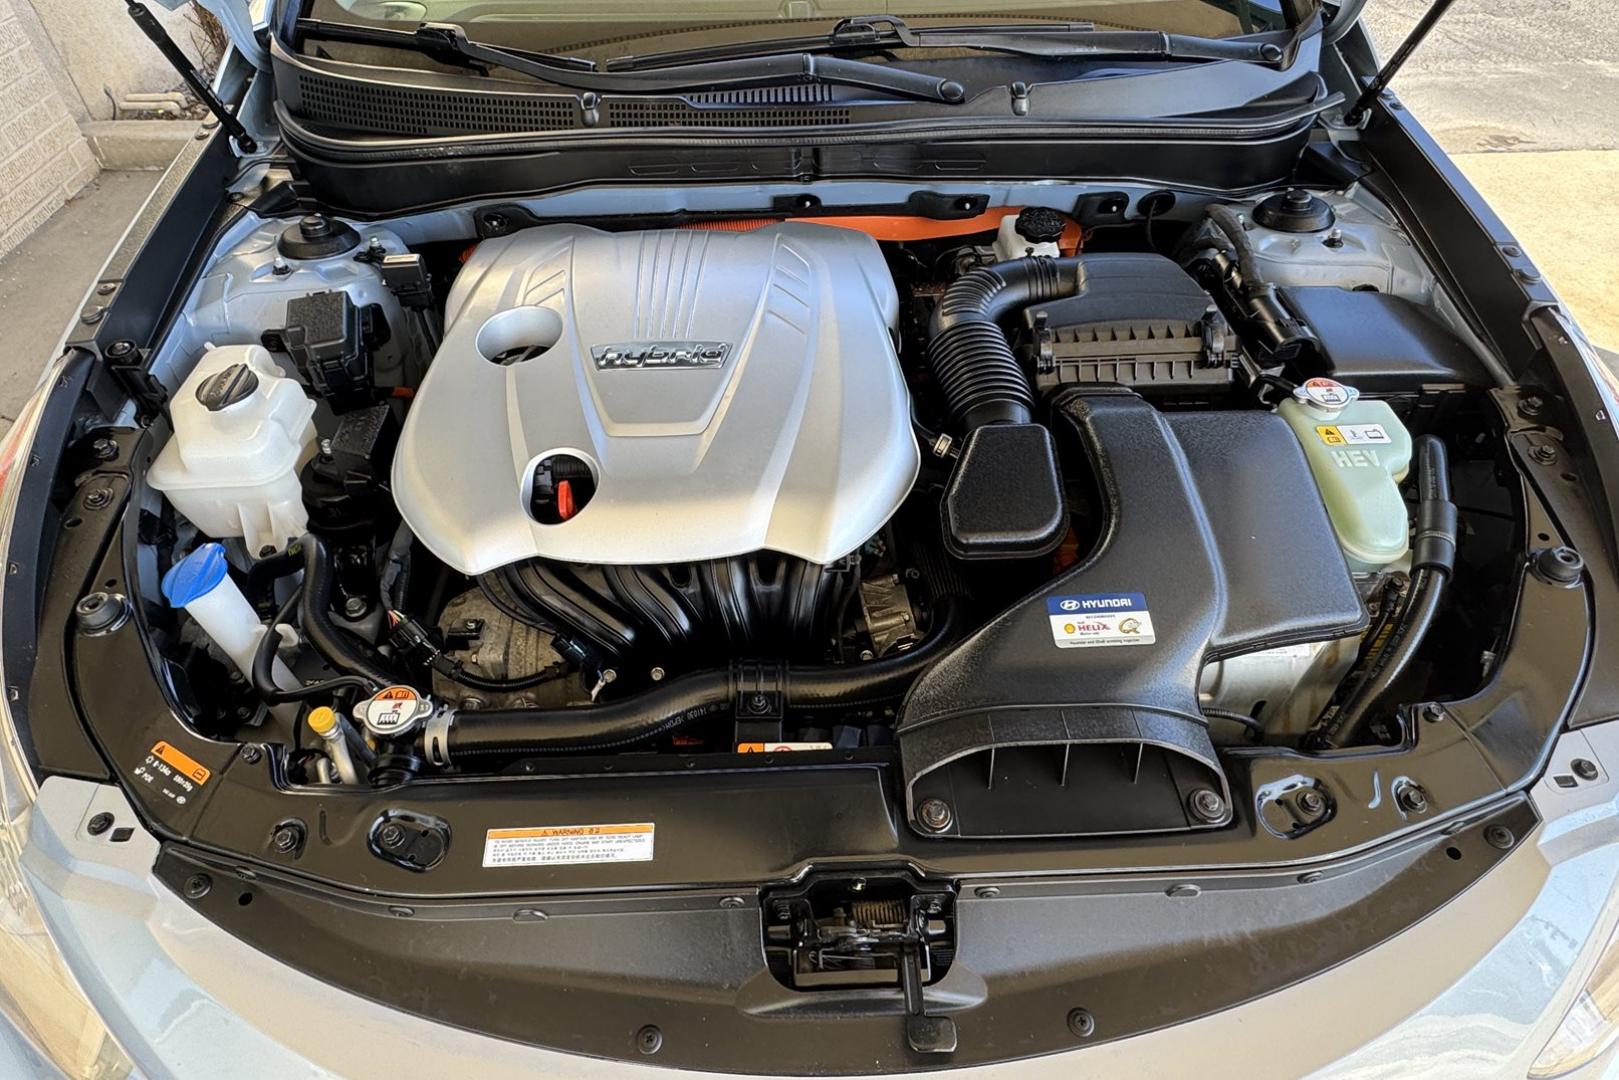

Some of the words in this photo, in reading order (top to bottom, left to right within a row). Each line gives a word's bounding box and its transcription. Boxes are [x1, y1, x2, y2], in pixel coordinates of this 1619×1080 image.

[598, 344, 728, 367] hybrid
[1331, 449, 1381, 467] HEV
[1082, 598, 1132, 609] HYUNDAI
[1078, 623, 1111, 631] HELIX
[551, 827, 584, 837] WARNING
